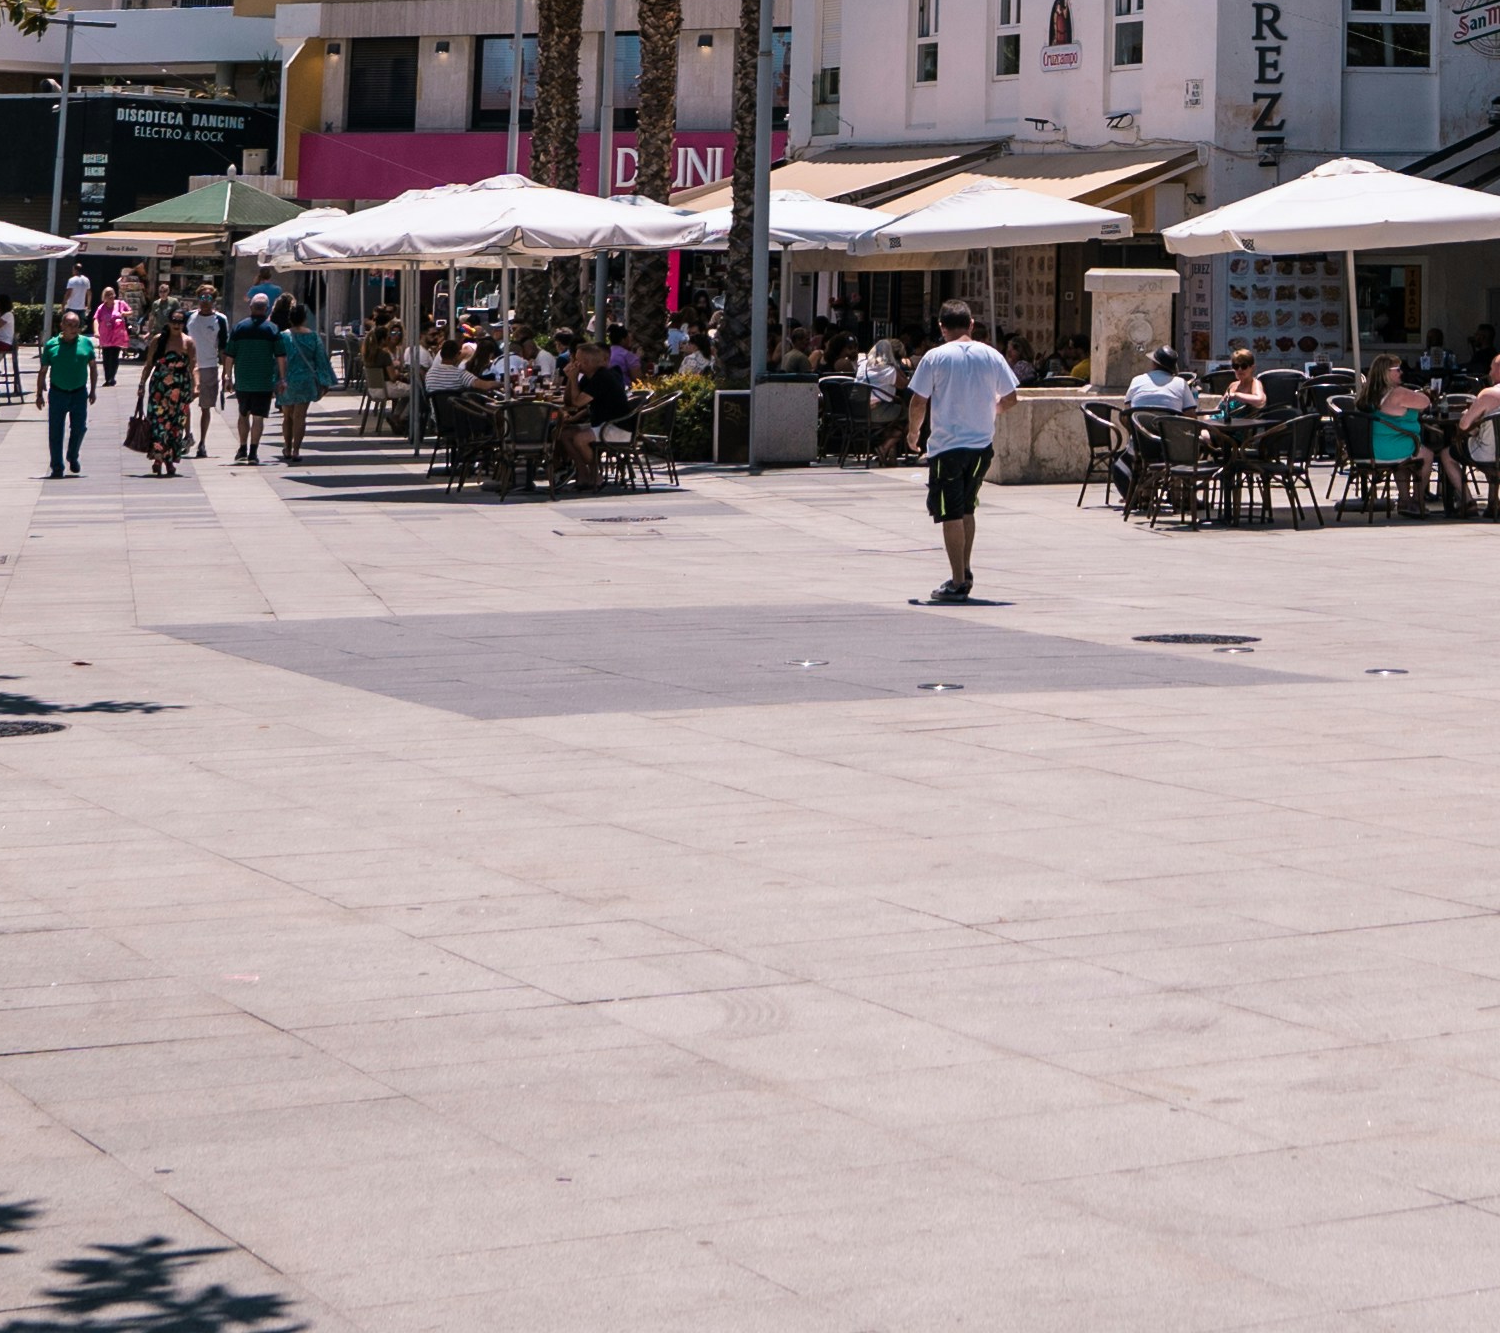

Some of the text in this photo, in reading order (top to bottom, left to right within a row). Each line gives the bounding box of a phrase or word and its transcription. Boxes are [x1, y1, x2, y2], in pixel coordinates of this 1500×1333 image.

[1043, 51, 1078, 67] Cruzcampo
[116, 108, 245, 129] DISCOTECA DANCING
[134, 125, 225, 142] ELECTRO & ROCK
[615, 147, 725, 188] DNI
[1191, 263, 1211, 278] JEREZ
[1407, 269, 1417, 325] TABACO
